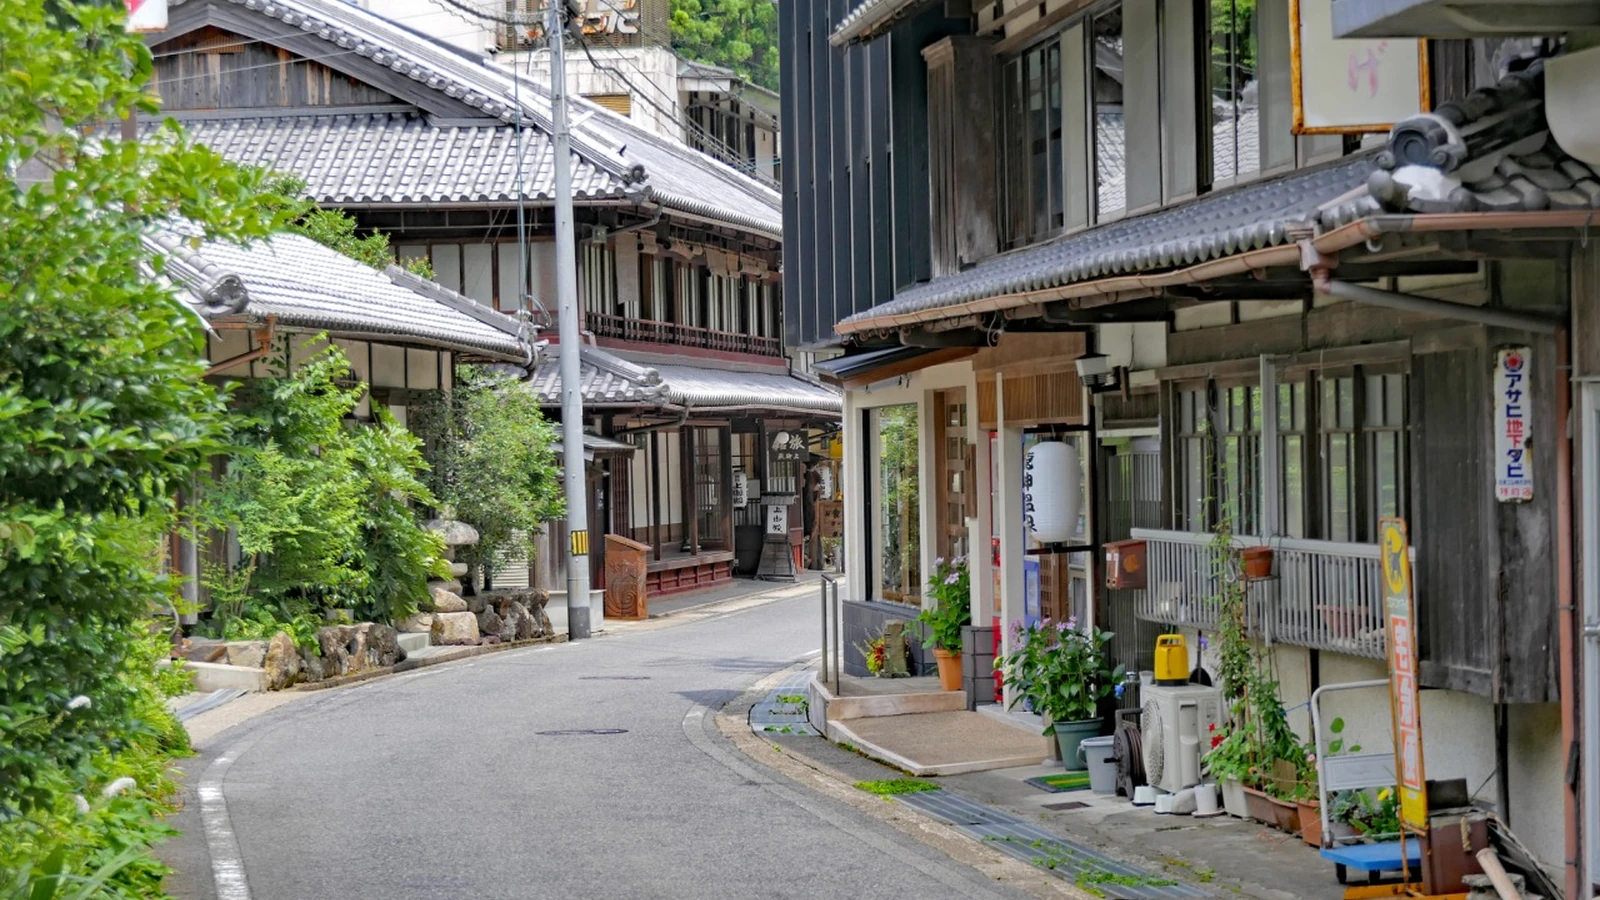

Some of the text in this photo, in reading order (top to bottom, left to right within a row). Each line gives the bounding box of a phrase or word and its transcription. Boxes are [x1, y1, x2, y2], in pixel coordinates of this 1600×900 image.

[1504, 373, 1524, 478] アサヒ地下タビ
